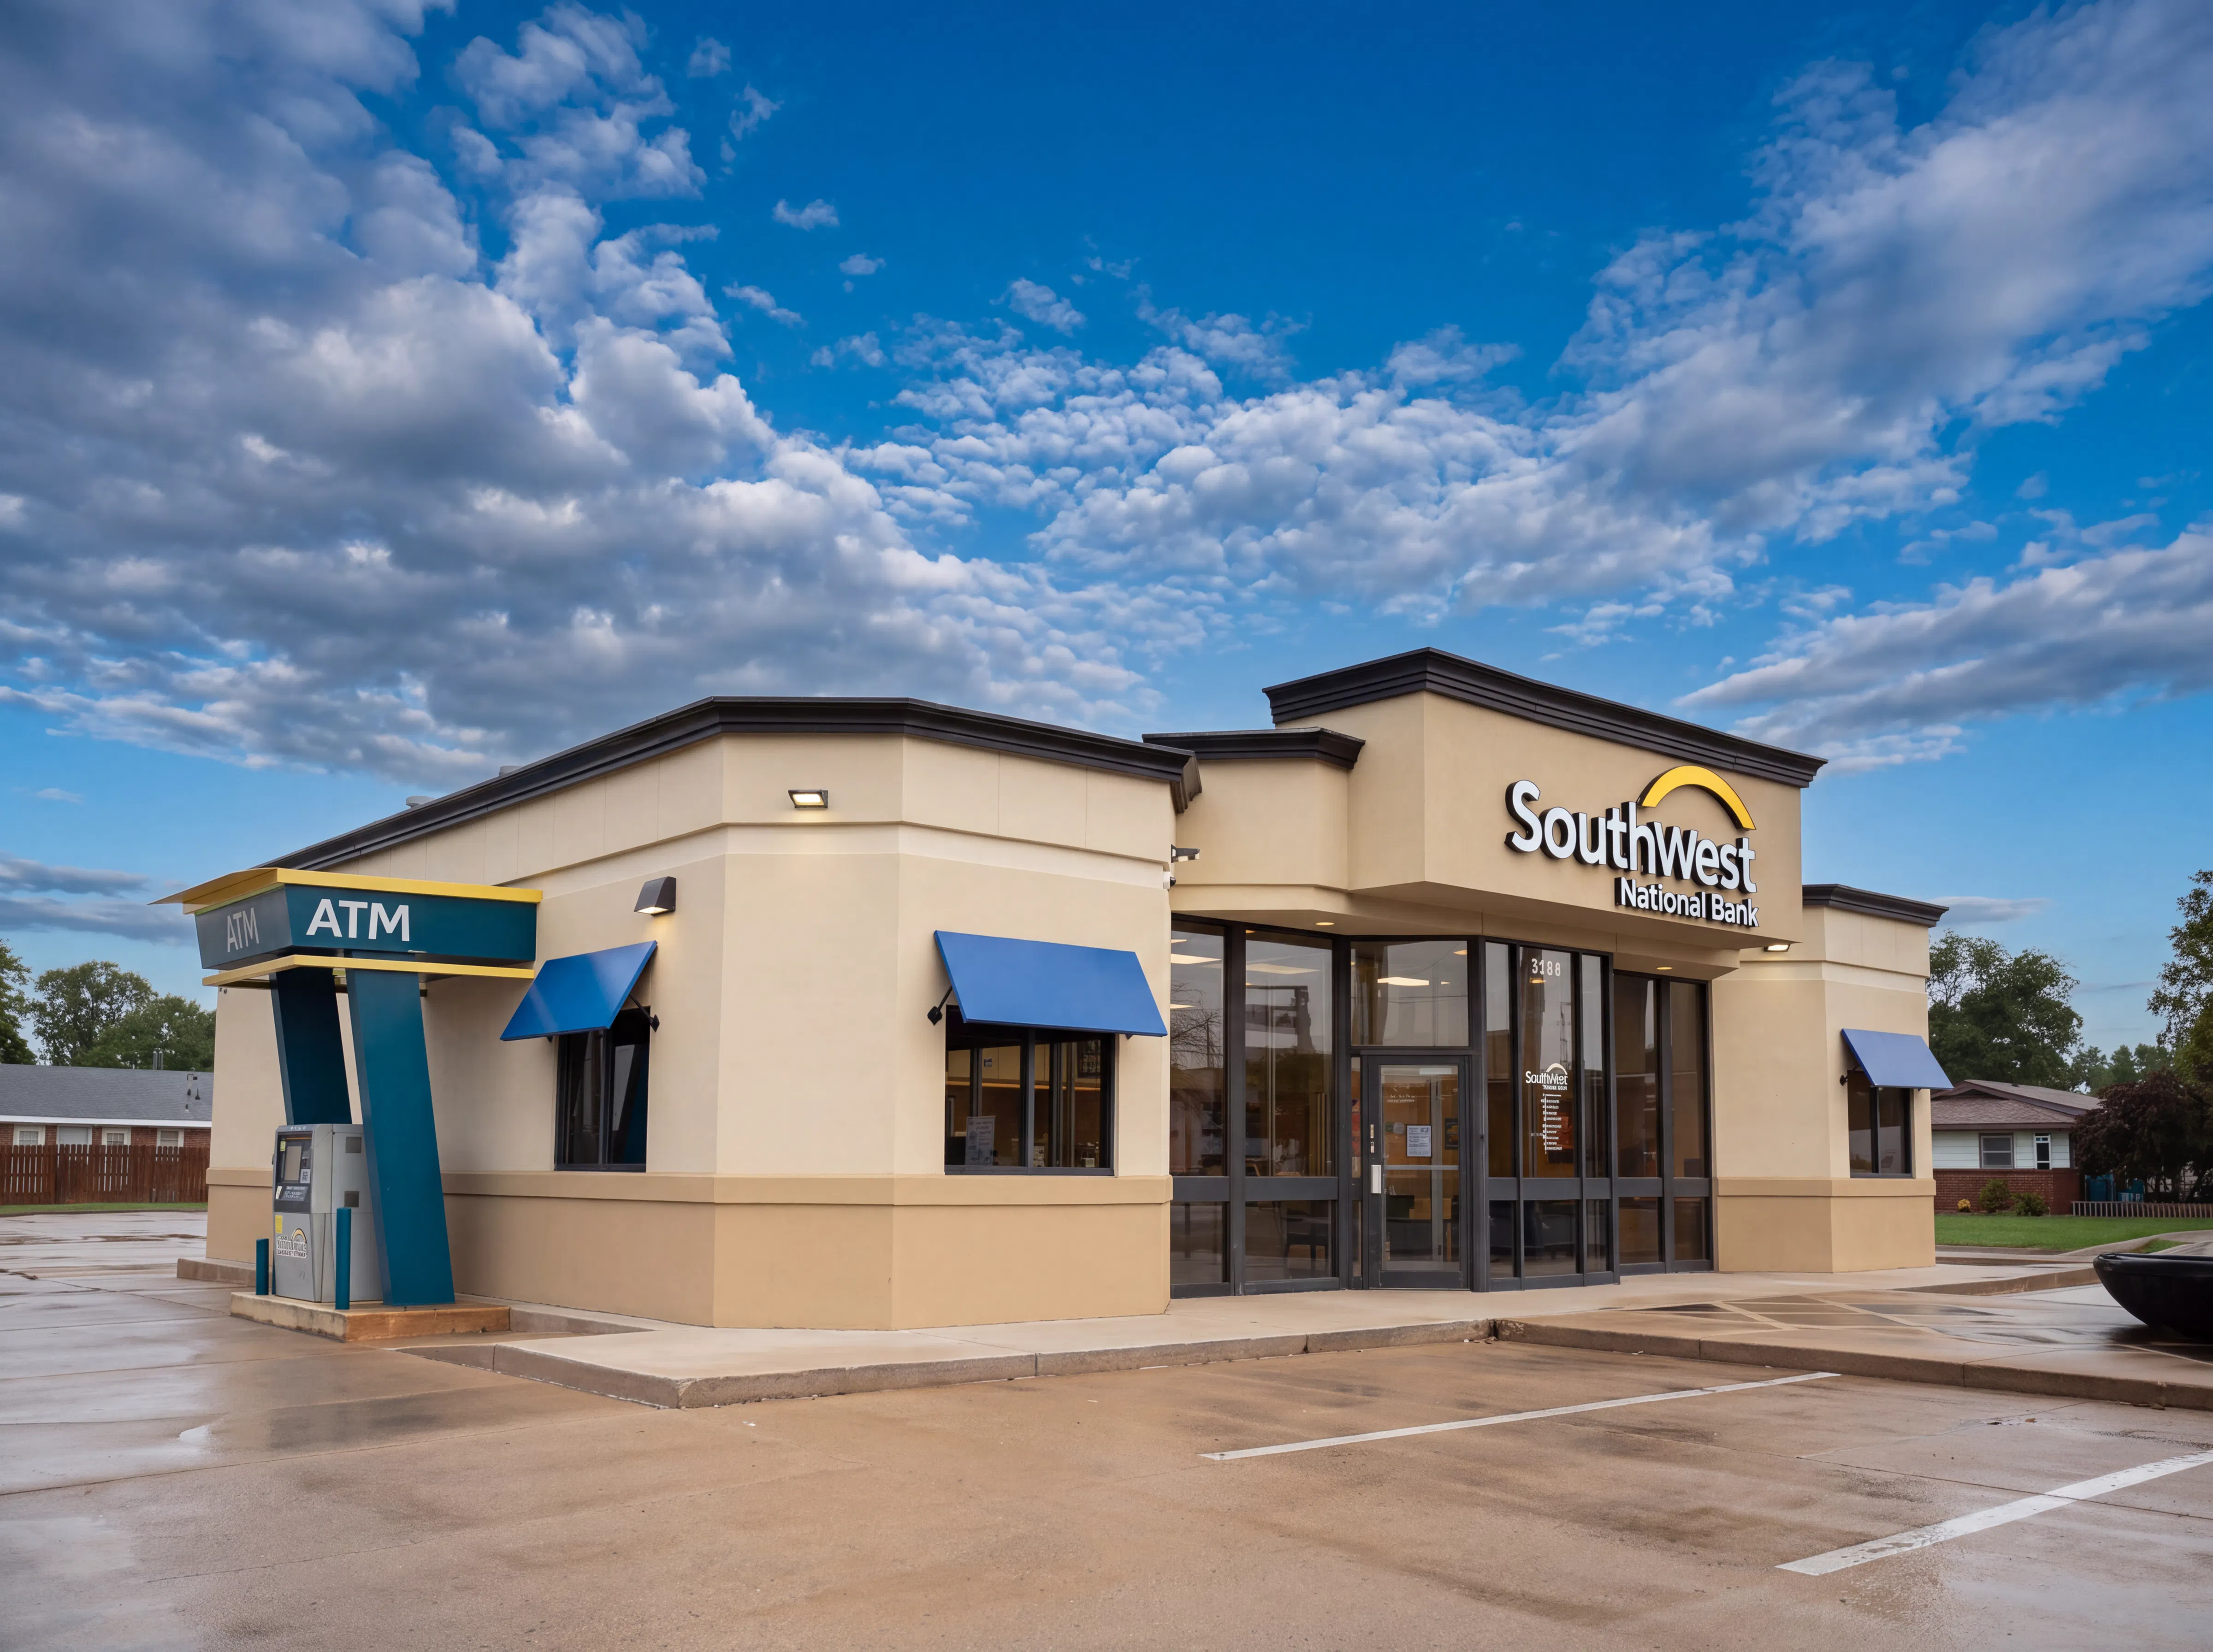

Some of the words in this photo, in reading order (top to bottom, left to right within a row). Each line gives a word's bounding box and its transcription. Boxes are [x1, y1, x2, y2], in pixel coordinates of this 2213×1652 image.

[306, 898, 410, 941] ATM
[1615, 877, 1705, 918] National
[1706, 892, 1759, 927] Bank
[227, 907, 259, 953] ATM
[1531, 958, 1561, 977] 3188
